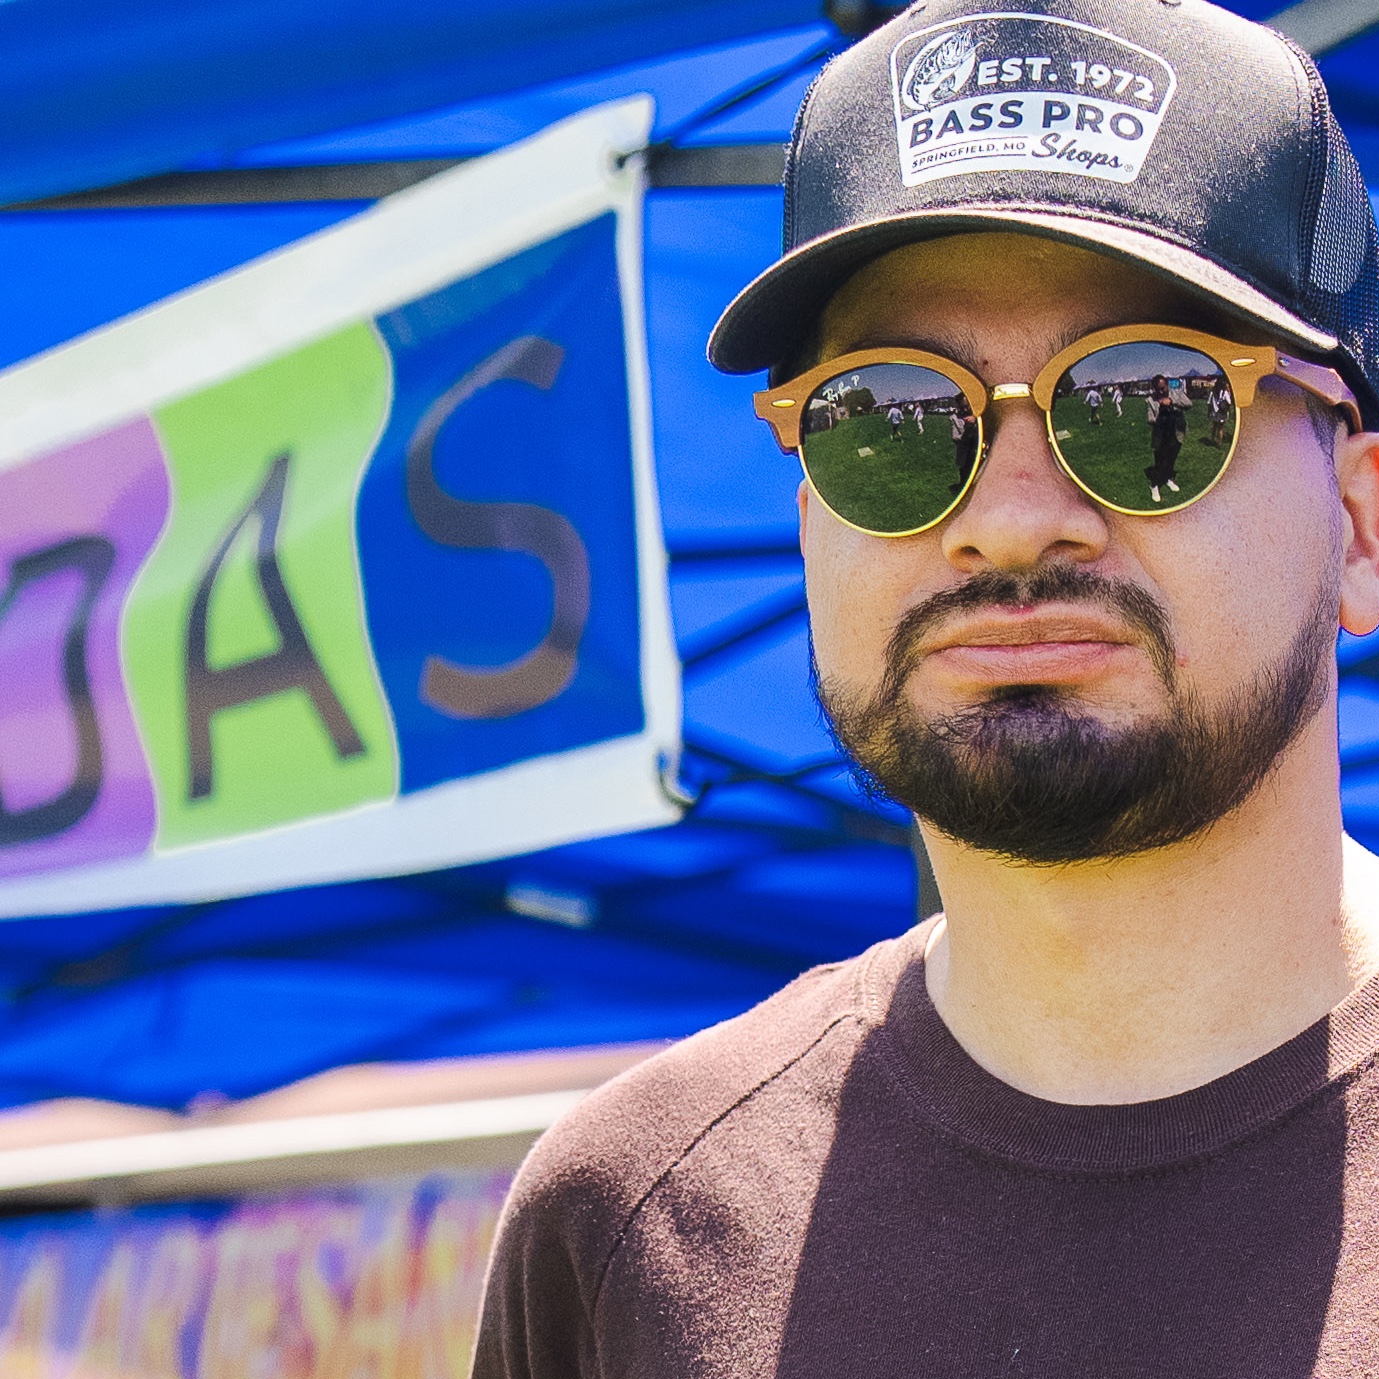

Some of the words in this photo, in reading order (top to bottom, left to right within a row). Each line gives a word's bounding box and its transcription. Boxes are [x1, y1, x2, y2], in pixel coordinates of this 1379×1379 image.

[977, 57, 1058, 86] EST.
[1070, 60, 1154, 102] 1972
[909, 99, 1024, 149] BASS
[1041, 99, 1144, 141] PRO
[1003, 141, 1026, 151] MO
